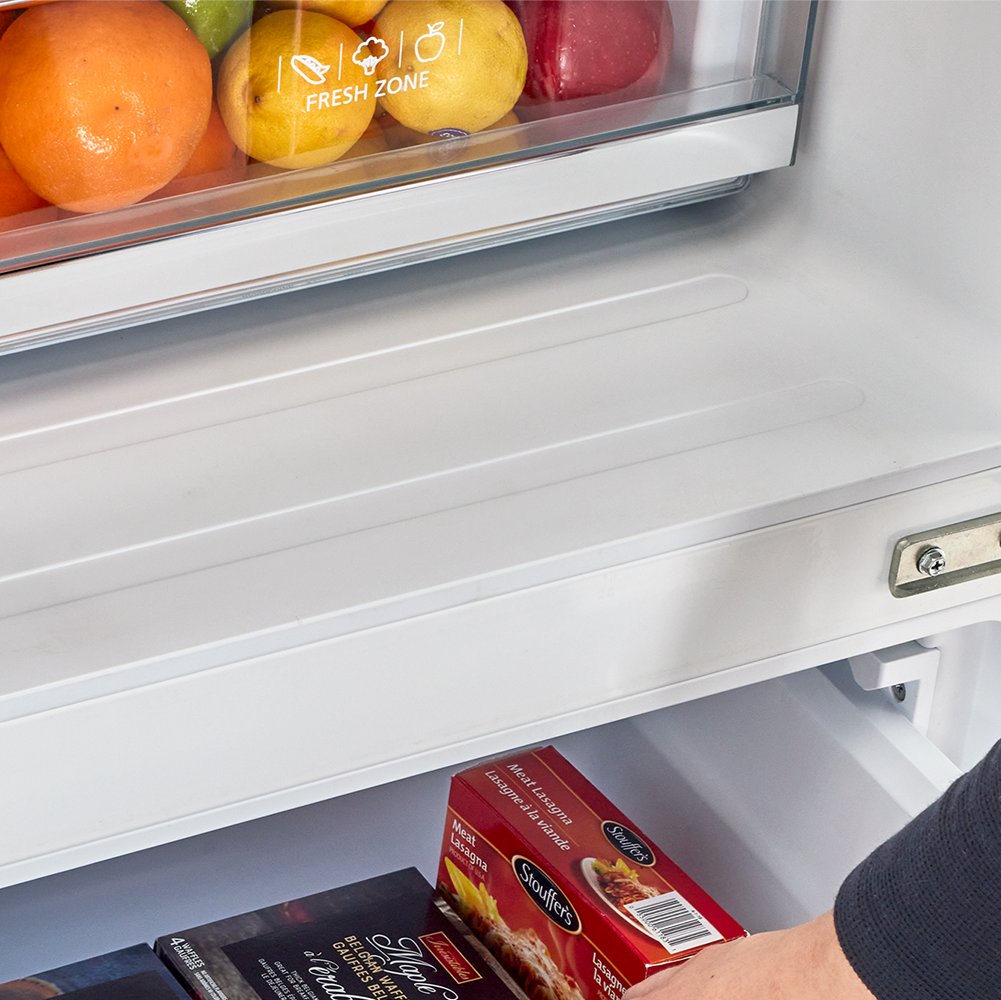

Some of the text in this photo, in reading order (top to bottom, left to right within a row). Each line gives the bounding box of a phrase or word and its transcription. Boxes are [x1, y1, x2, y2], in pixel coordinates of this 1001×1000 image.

[306, 70, 430, 112] FRESH ZONE
[484, 770, 571, 852] Lasagne à la viande
[506, 763, 573, 826] Meat Lasagna
[452, 819, 477, 848] Meat
[606, 825, 649, 863] Stouffer's
[450, 832, 488, 873] Lasagna
[519, 863, 573, 926] Stouffer's
[170, 936, 206, 968] 4 WAFFLES
[173, 945, 198, 972] GAUFRES
[333, 942, 373, 983] GAUFRES
[345, 936, 385, 973] BELGIAN
[258, 959, 277, 978] GAUFRES
[274, 978, 290, 994] BELGES
[274, 961, 289, 975] GREAT
[286, 975, 296, 984] FOR
[291, 970, 304, 984] THICK
[592, 952, 627, 995] Lasagne
[593, 967, 602, 987] la
